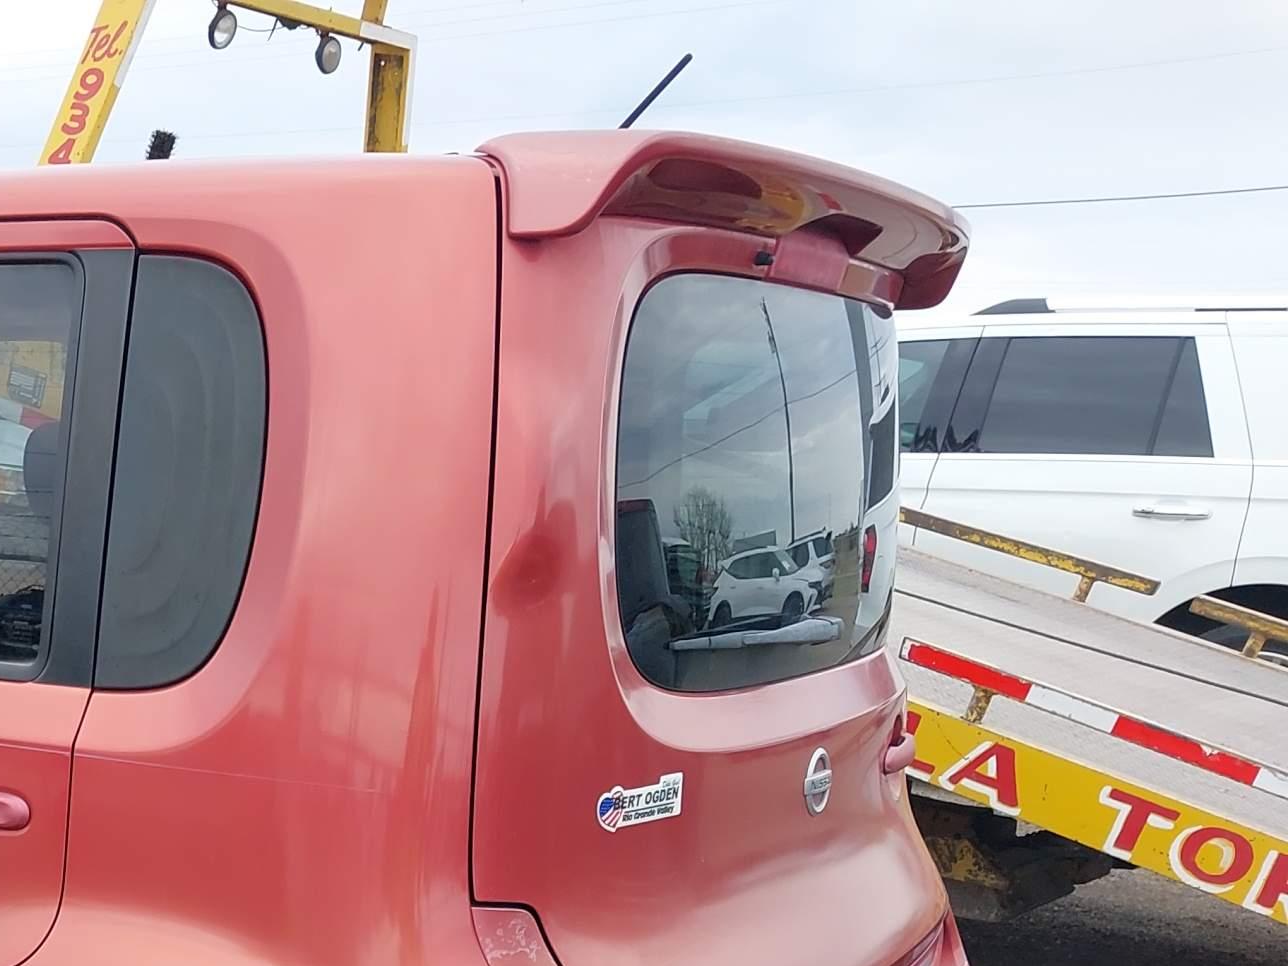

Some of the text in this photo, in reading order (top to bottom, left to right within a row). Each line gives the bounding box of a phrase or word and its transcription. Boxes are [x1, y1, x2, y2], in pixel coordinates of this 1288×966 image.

[81, 20, 128, 64] Tel.
[613, 786, 680, 812] BERT OGDEN
[633, 808, 655, 820] Grande
[656, 804, 674, 816] Valley
